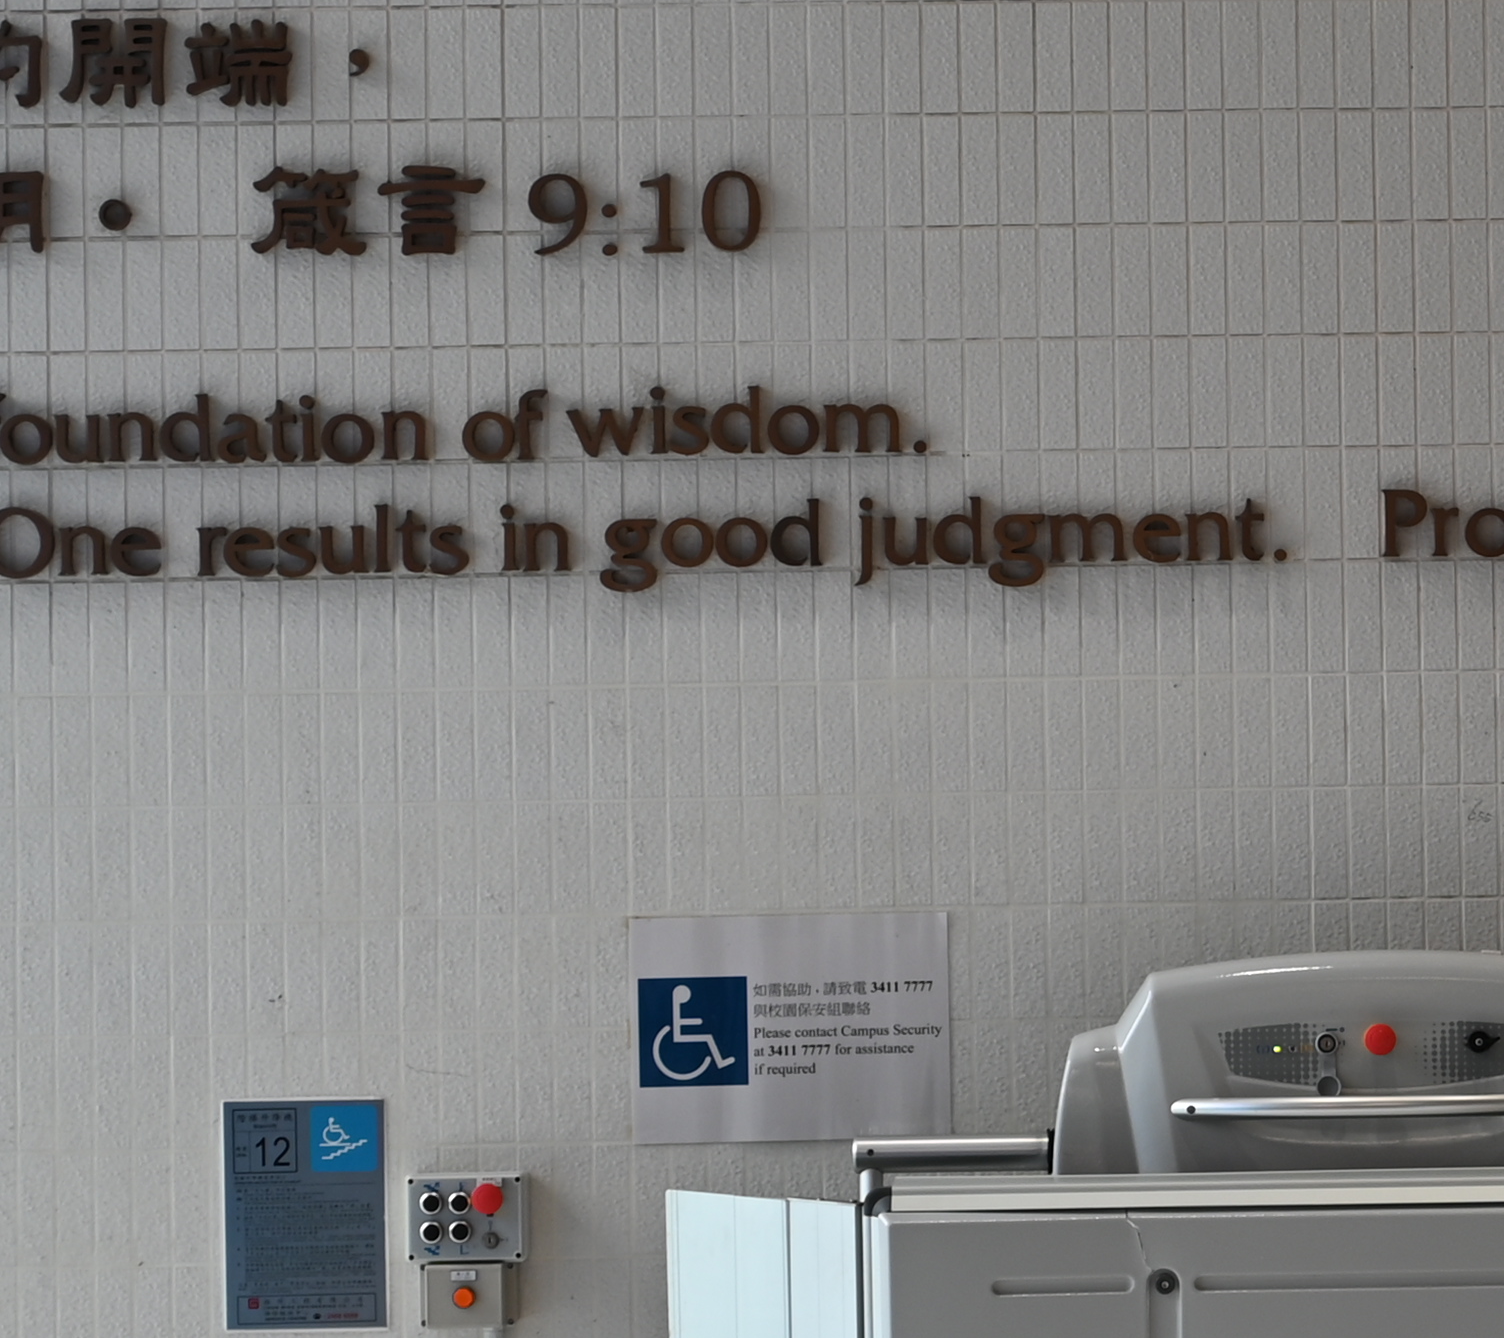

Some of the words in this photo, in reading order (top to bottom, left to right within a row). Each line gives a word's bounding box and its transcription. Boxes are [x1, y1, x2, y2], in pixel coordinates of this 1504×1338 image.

[527, 169, 763, 257] 9:10
[461, 388, 547, 461] of
[566, 385, 929, 459] wisdom.
[197, 503, 470, 579] results
[499, 504, 570, 575] in
[600, 498, 824, 592] good
[853, 495, 1289, 588] judgment.
[870, 981, 899, 993] 3411
[903, 980, 933, 992] 7777
[754, 1027, 791, 1039] Please
[795, 1026, 838, 1038] contact
[840, 1025, 890, 1039] Campus
[893, 1023, 942, 1039] Security
[753, 1046, 764, 1057] at
[768, 1045, 796, 1057] 3411
[801, 1044, 831, 1056] 7777
[835, 1043, 852, 1055] for
[855, 1043, 914, 1054] assistance
[754, 1063, 764, 1075] if
[767, 1062, 816, 1077] required
[255, 1136, 291, 1168] 12
